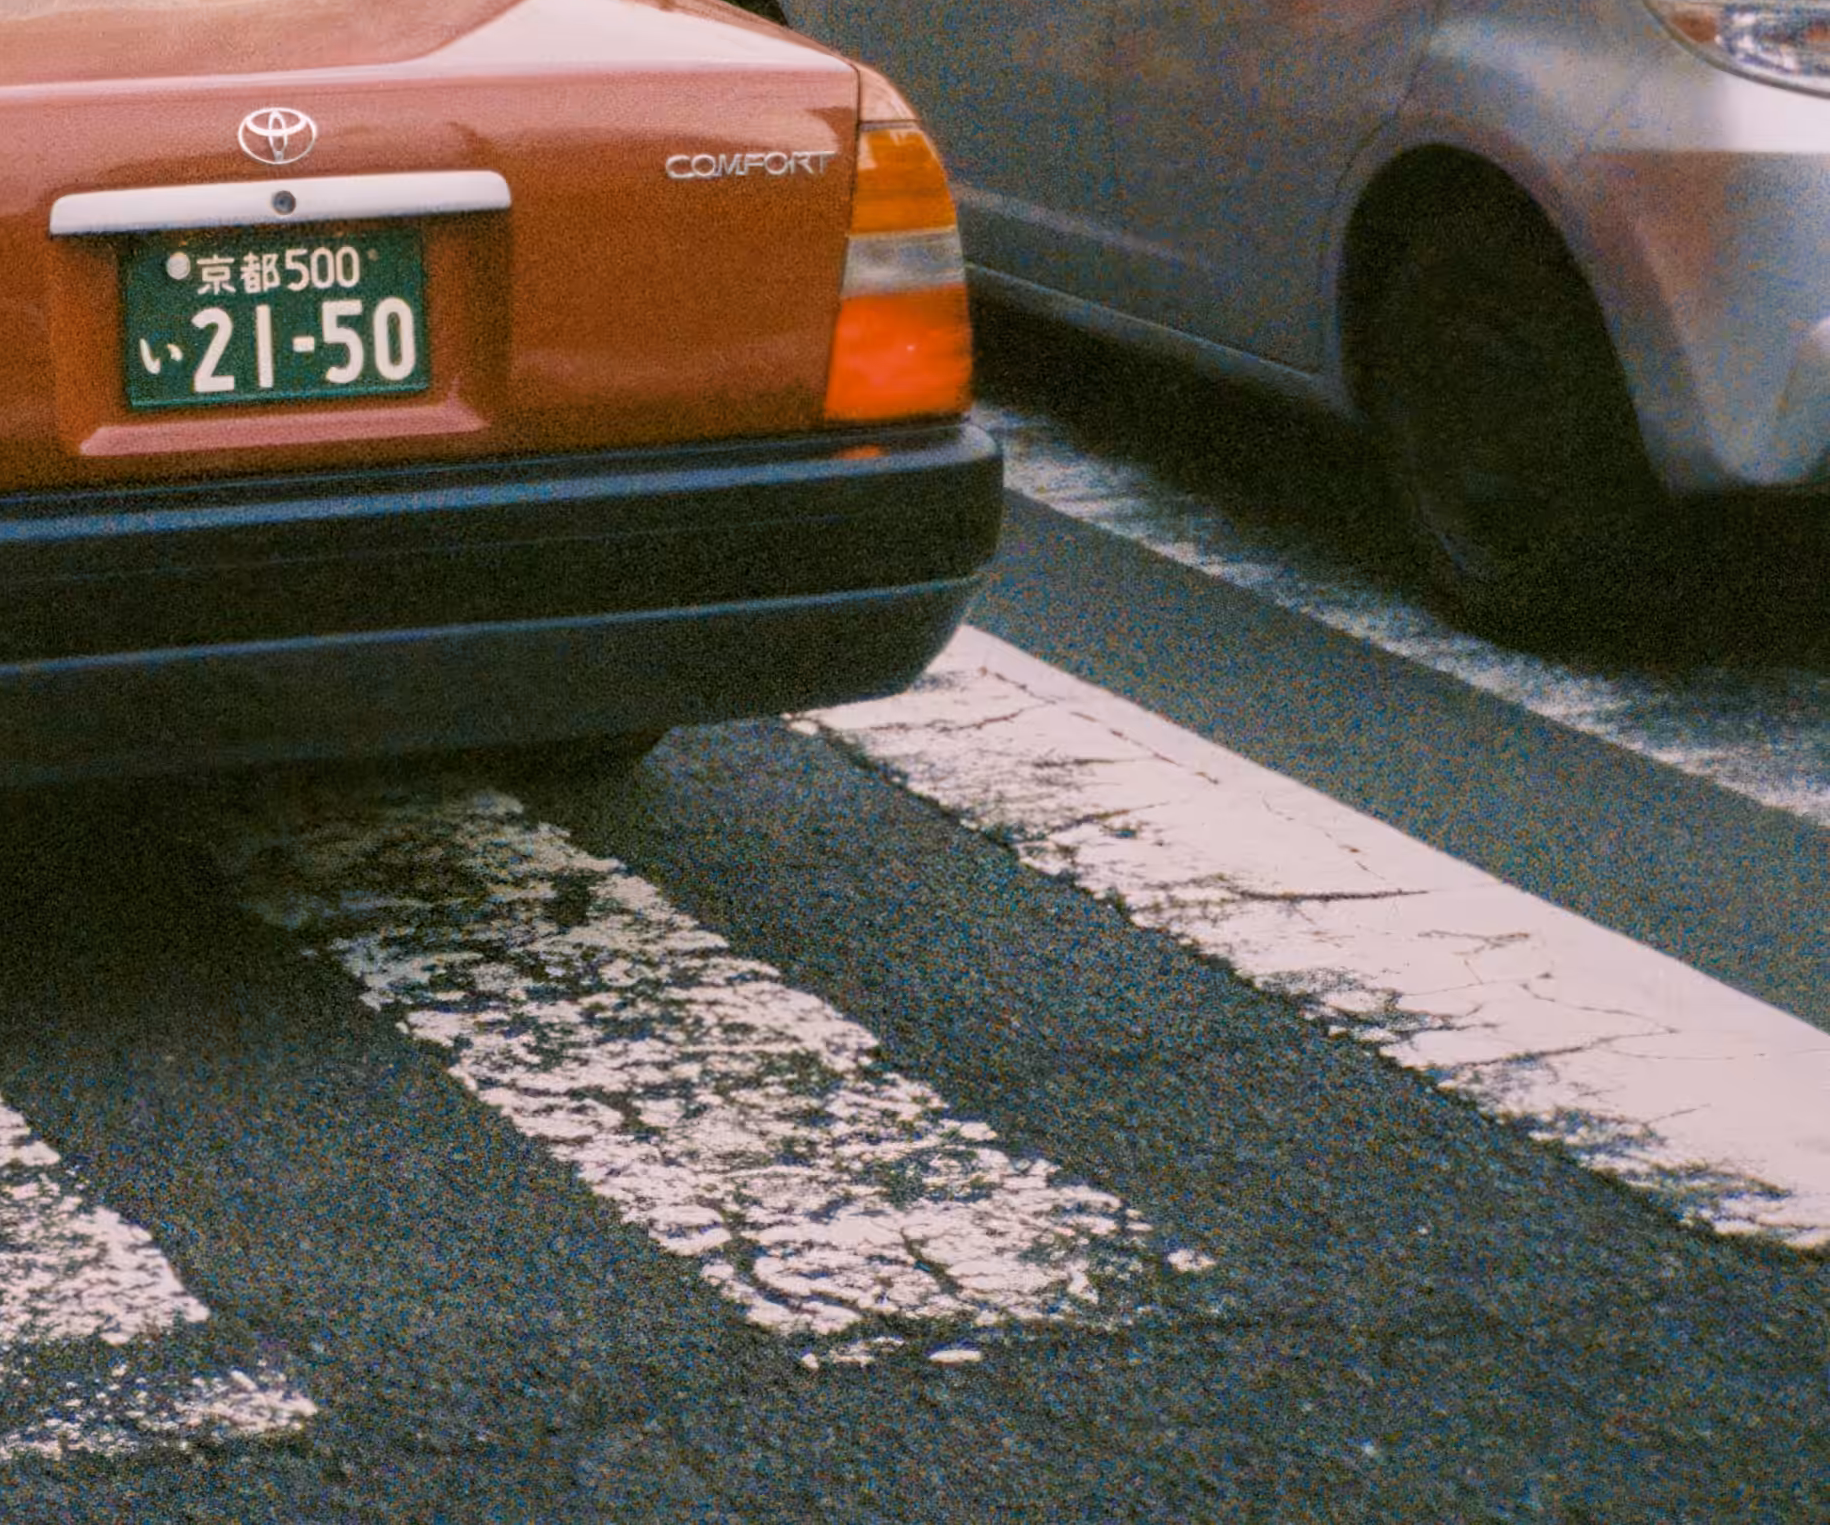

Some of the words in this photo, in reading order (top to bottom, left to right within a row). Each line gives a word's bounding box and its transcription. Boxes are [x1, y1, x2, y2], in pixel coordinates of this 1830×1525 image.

[665, 150, 837, 178] COMFORT
[140, 338, 183, 375] い
[191, 297, 416, 392] 21-50
